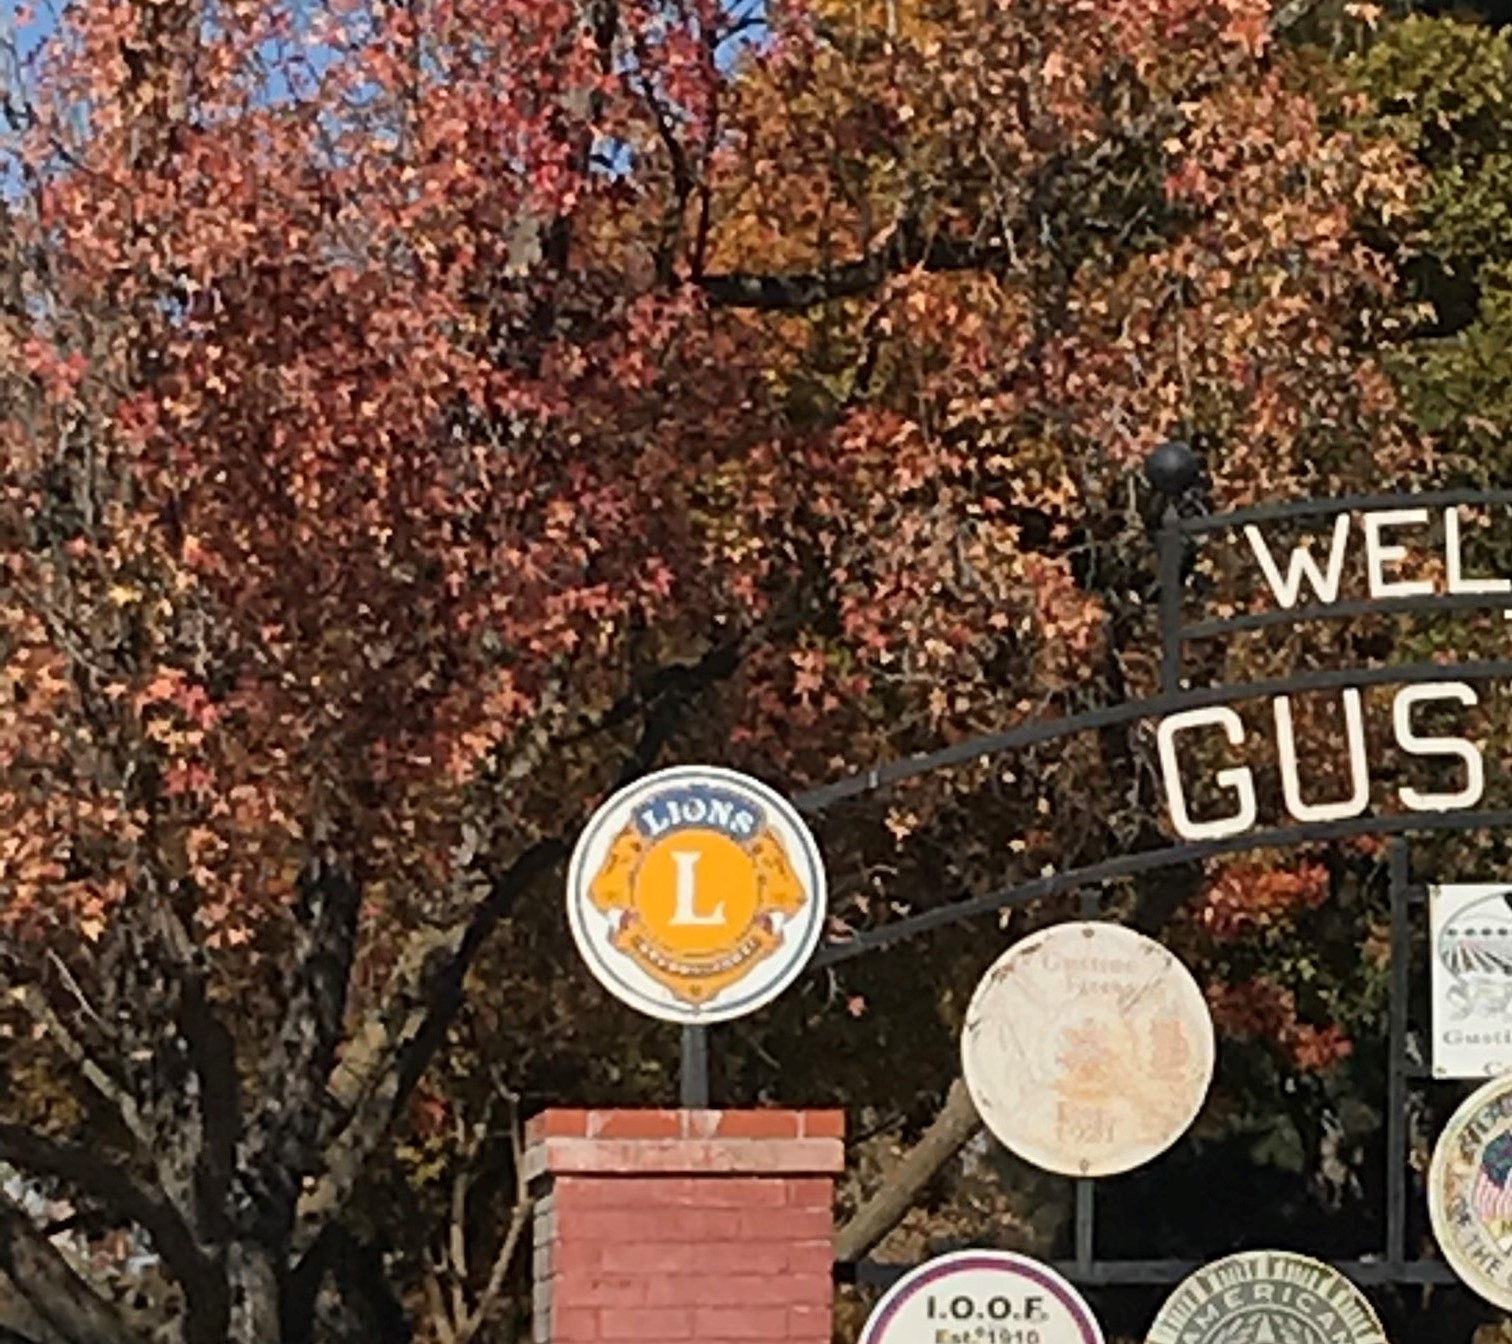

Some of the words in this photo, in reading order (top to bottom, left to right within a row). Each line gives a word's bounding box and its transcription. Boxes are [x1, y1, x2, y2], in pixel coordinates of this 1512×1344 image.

[642, 797, 755, 834] LIONS
[668, 850, 727, 925] L
[1464, 1234, 1504, 1278] THE
